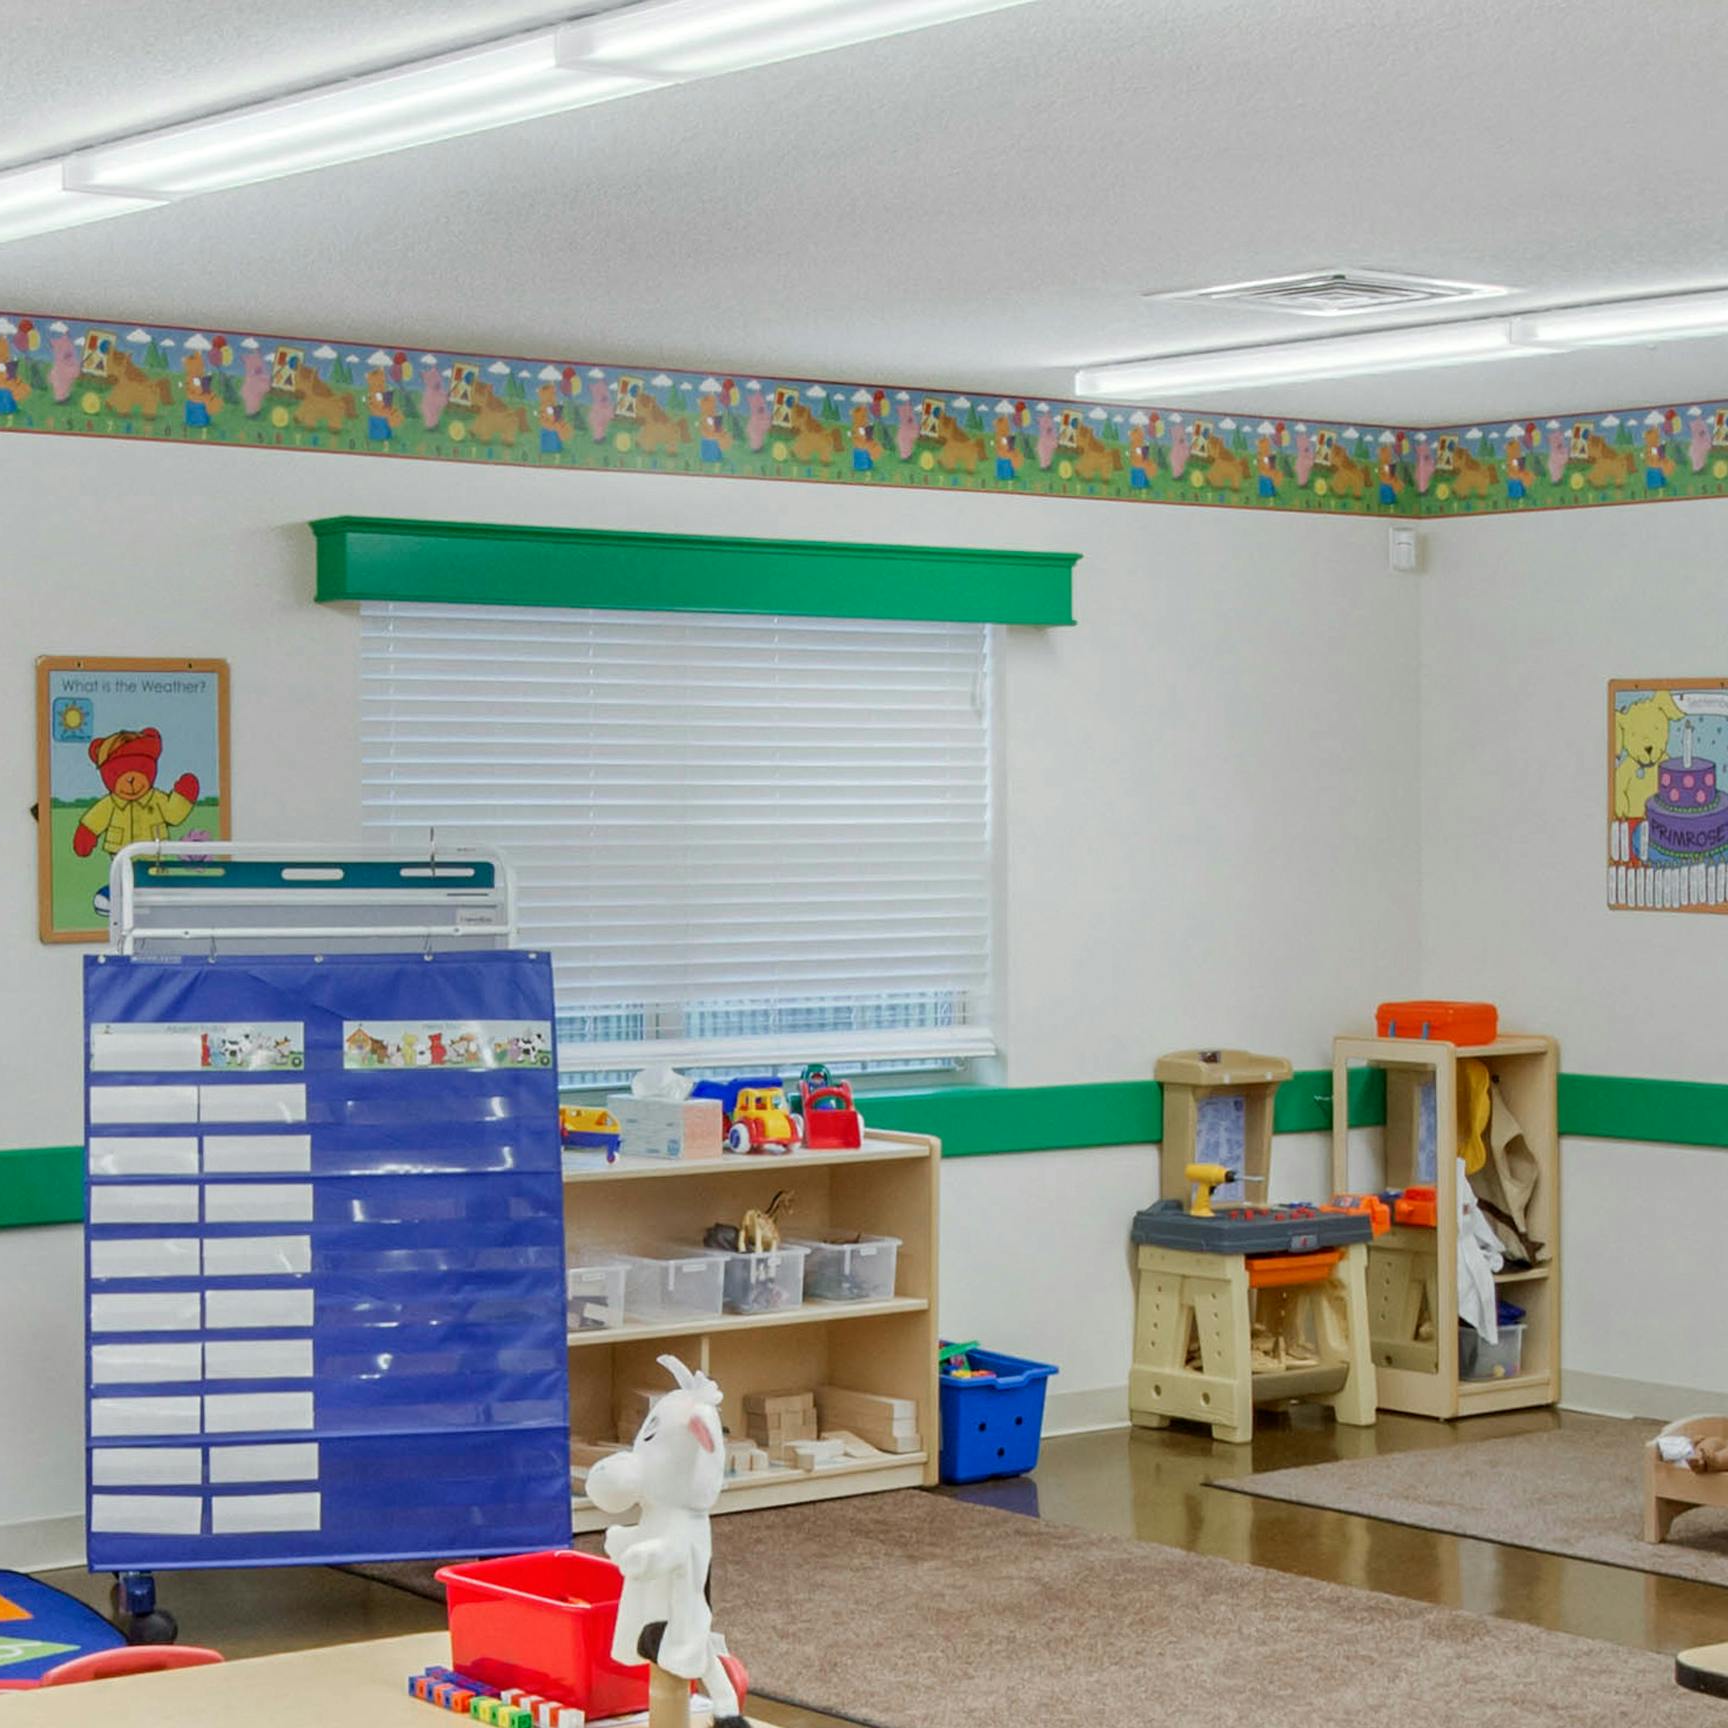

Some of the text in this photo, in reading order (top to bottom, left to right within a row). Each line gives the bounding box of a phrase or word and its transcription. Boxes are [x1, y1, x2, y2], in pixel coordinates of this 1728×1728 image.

[62, 679, 207, 694] What is the Weather?
